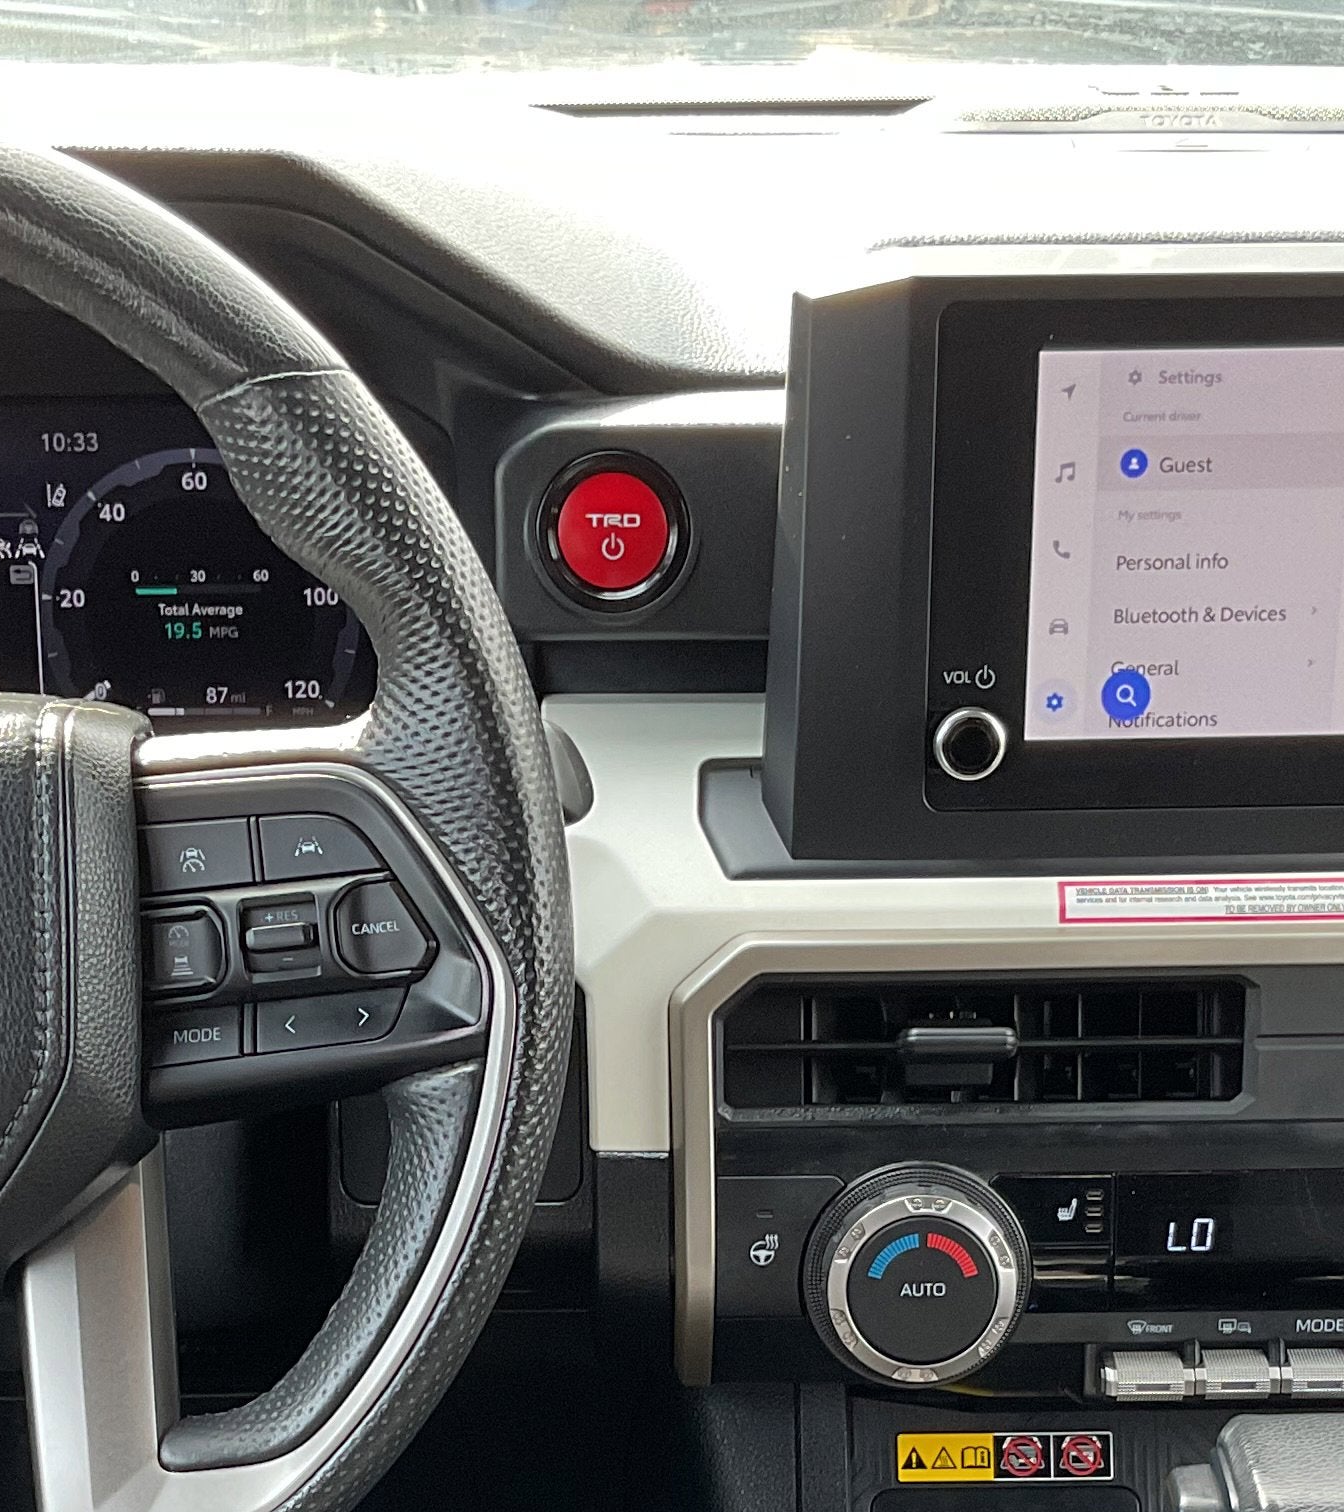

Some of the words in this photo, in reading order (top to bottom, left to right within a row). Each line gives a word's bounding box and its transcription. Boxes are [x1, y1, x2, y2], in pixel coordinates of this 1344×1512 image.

[1139, 114, 1223, 128] TOYOTA
[1158, 369, 1223, 387] Settings
[1122, 411, 1166, 422] Current
[1168, 410, 1201, 422] driver
[40, 431, 100, 453] 10:33
[1158, 456, 1213, 473] Guest
[181, 472, 208, 491] 60
[98, 503, 126, 522] 40
[584, 512, 642, 529] TRD
[1117, 509, 1135, 523] My
[1137, 510, 1182, 523] settings
[1115, 553, 1192, 571] Personal
[1195, 552, 1229, 570] info
[130, 570, 140, 583] 0
[189, 570, 206, 583] 30
[252, 569, 270, 583] 60
[59, 589, 86, 608] 20
[303, 587, 339, 607] 100
[157, 603, 189, 617] Total
[191, 603, 244, 619] Average
[1113, 606, 1199, 624] Bluetooth
[1202, 606, 1216, 623] &
[1220, 604, 1287, 623] Devices
[164, 621, 203, 640] 19.5
[209, 625, 239, 640] MPG
[942, 670, 972, 685] VOL
[95, 682, 107, 701] 0
[205, 686, 229, 704] 87
[230, 692, 246, 704] mi
[284, 679, 321, 700] 120
[350, 919, 401, 937] CANCEL
[172, 1026, 222, 1045] MODE
[1167, 1217, 1216, 1254] LO
[899, 1281, 947, 1299] AUTO
[1144, 1322, 1174, 1335] FRONT
[1294, 1317, 1344, 1334] MODE
